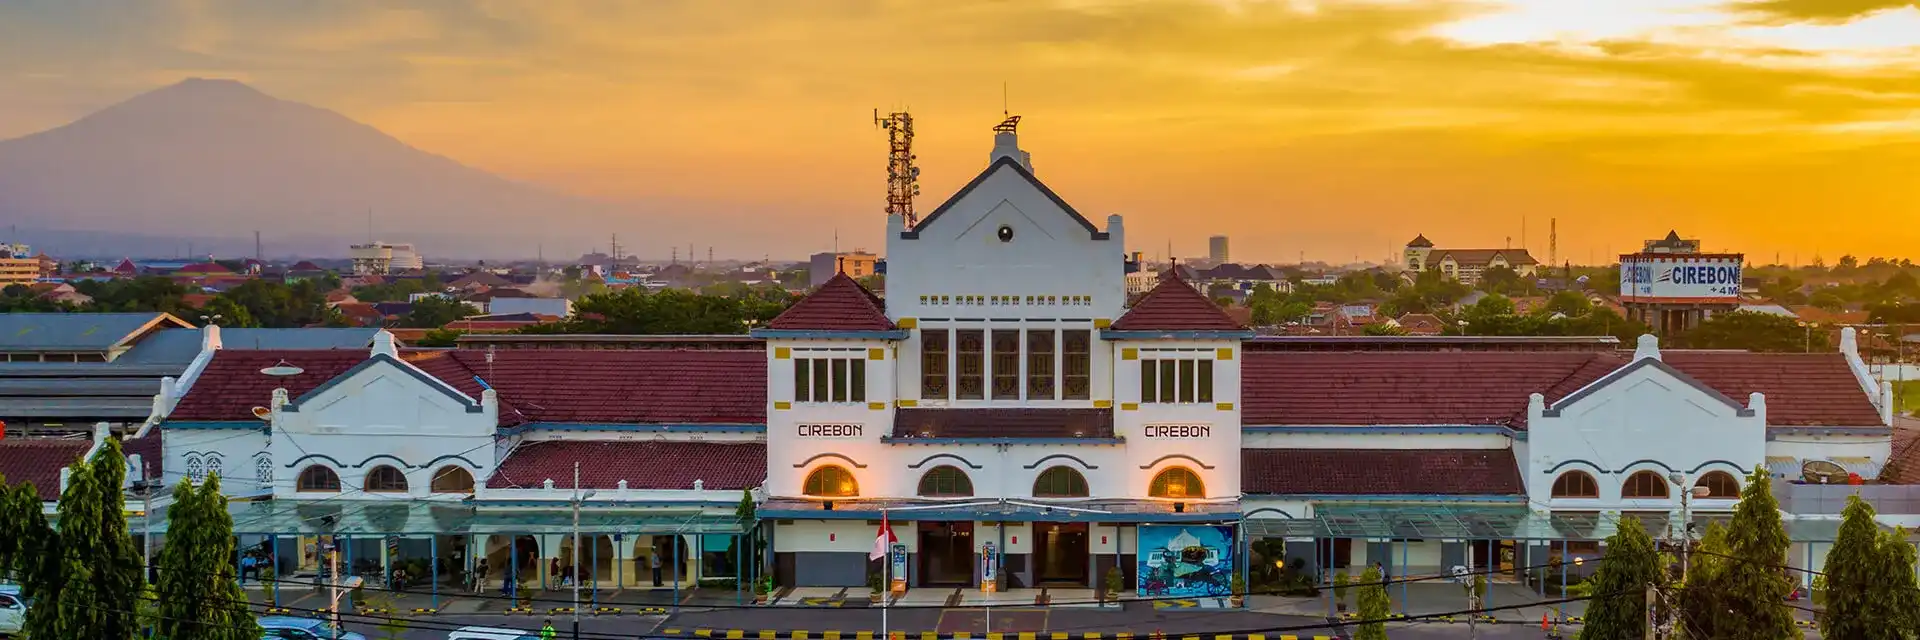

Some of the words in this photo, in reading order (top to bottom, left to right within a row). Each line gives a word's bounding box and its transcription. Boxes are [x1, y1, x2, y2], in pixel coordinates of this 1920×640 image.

[1672, 266, 1737, 285] CIREBON
[798, 424, 863, 437] CIREBON
[1144, 425, 1210, 438] CIREBON
